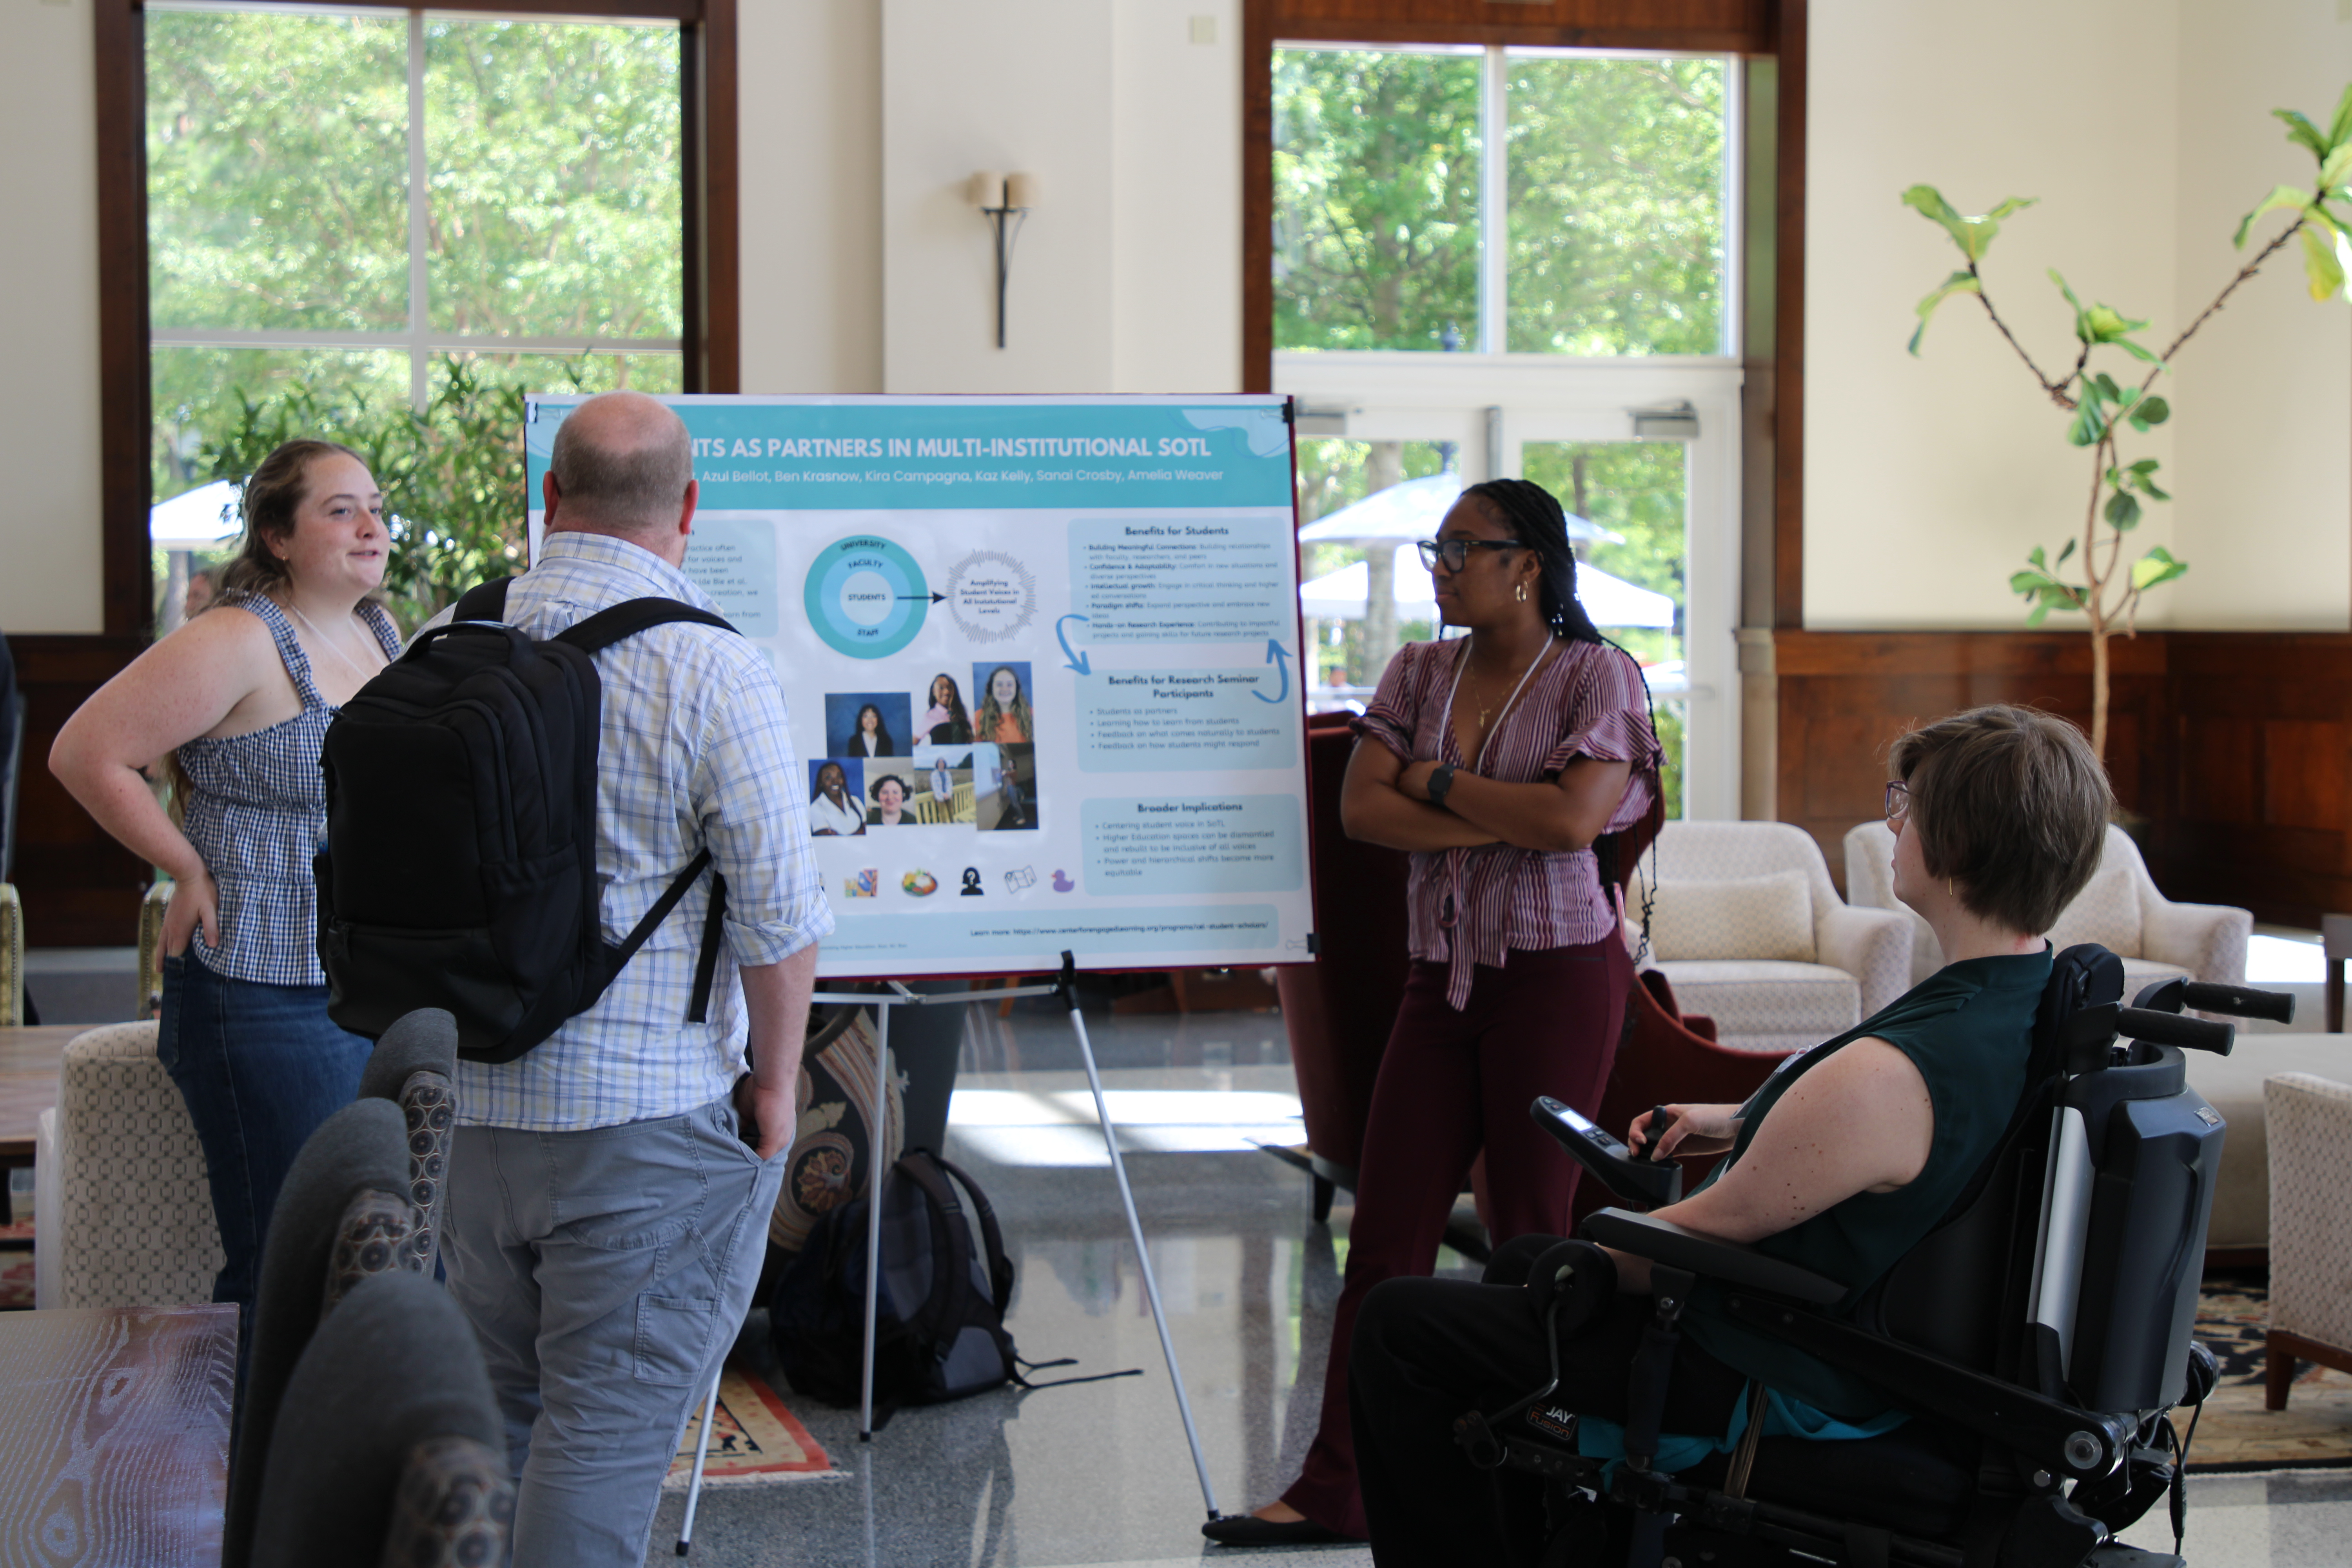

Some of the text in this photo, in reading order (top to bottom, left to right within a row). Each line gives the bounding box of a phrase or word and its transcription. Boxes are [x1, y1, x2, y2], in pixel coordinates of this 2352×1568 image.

[731, 438, 762, 457] AS
[768, 438, 883, 457] PARTNERS
[889, 438, 911, 457] IN
[917, 437, 1152, 457] MULTI-INSTITUTIONAL
[1158, 437, 1212, 457] SOTL
[702, 470, 729, 482] Azul
[733, 470, 772, 483] Bellot,
[775, 470, 800, 482] Ben
[803, 470, 862, 483] Krasnow,
[866, 470, 890, 482] Kira
[893, 470, 973, 485] Campagna,
[976, 470, 998, 481] Kaz
[1002, 470, 1034, 483] Kelly,
[1037, 470, 1073, 481] Sanai
[1076, 470, 1124, 483] Crosby,
[1128, 470, 1172, 481] Amelia
[1176, 470, 1223, 480] Weaver
[1125, 526, 1229, 535] Benefits for Students
[840, 539, 886, 551] UNIVERSITY
[848, 559, 883, 568] FACULTY
[1109, 674, 1259, 684] Benefits for Research Seminar
[1154, 689, 1214, 700] Participants
[1198, 729, 1234, 737] naturally
[1203, 741, 1226, 749] might
[1138, 802, 1243, 814] Broader Implications
[1103, 822, 1140, 830] Centering
[1103, 834, 1127, 842] Higher
[1546, 1406, 1573, 1424] JAY
[1530, 1411, 1569, 1437] Fusion
